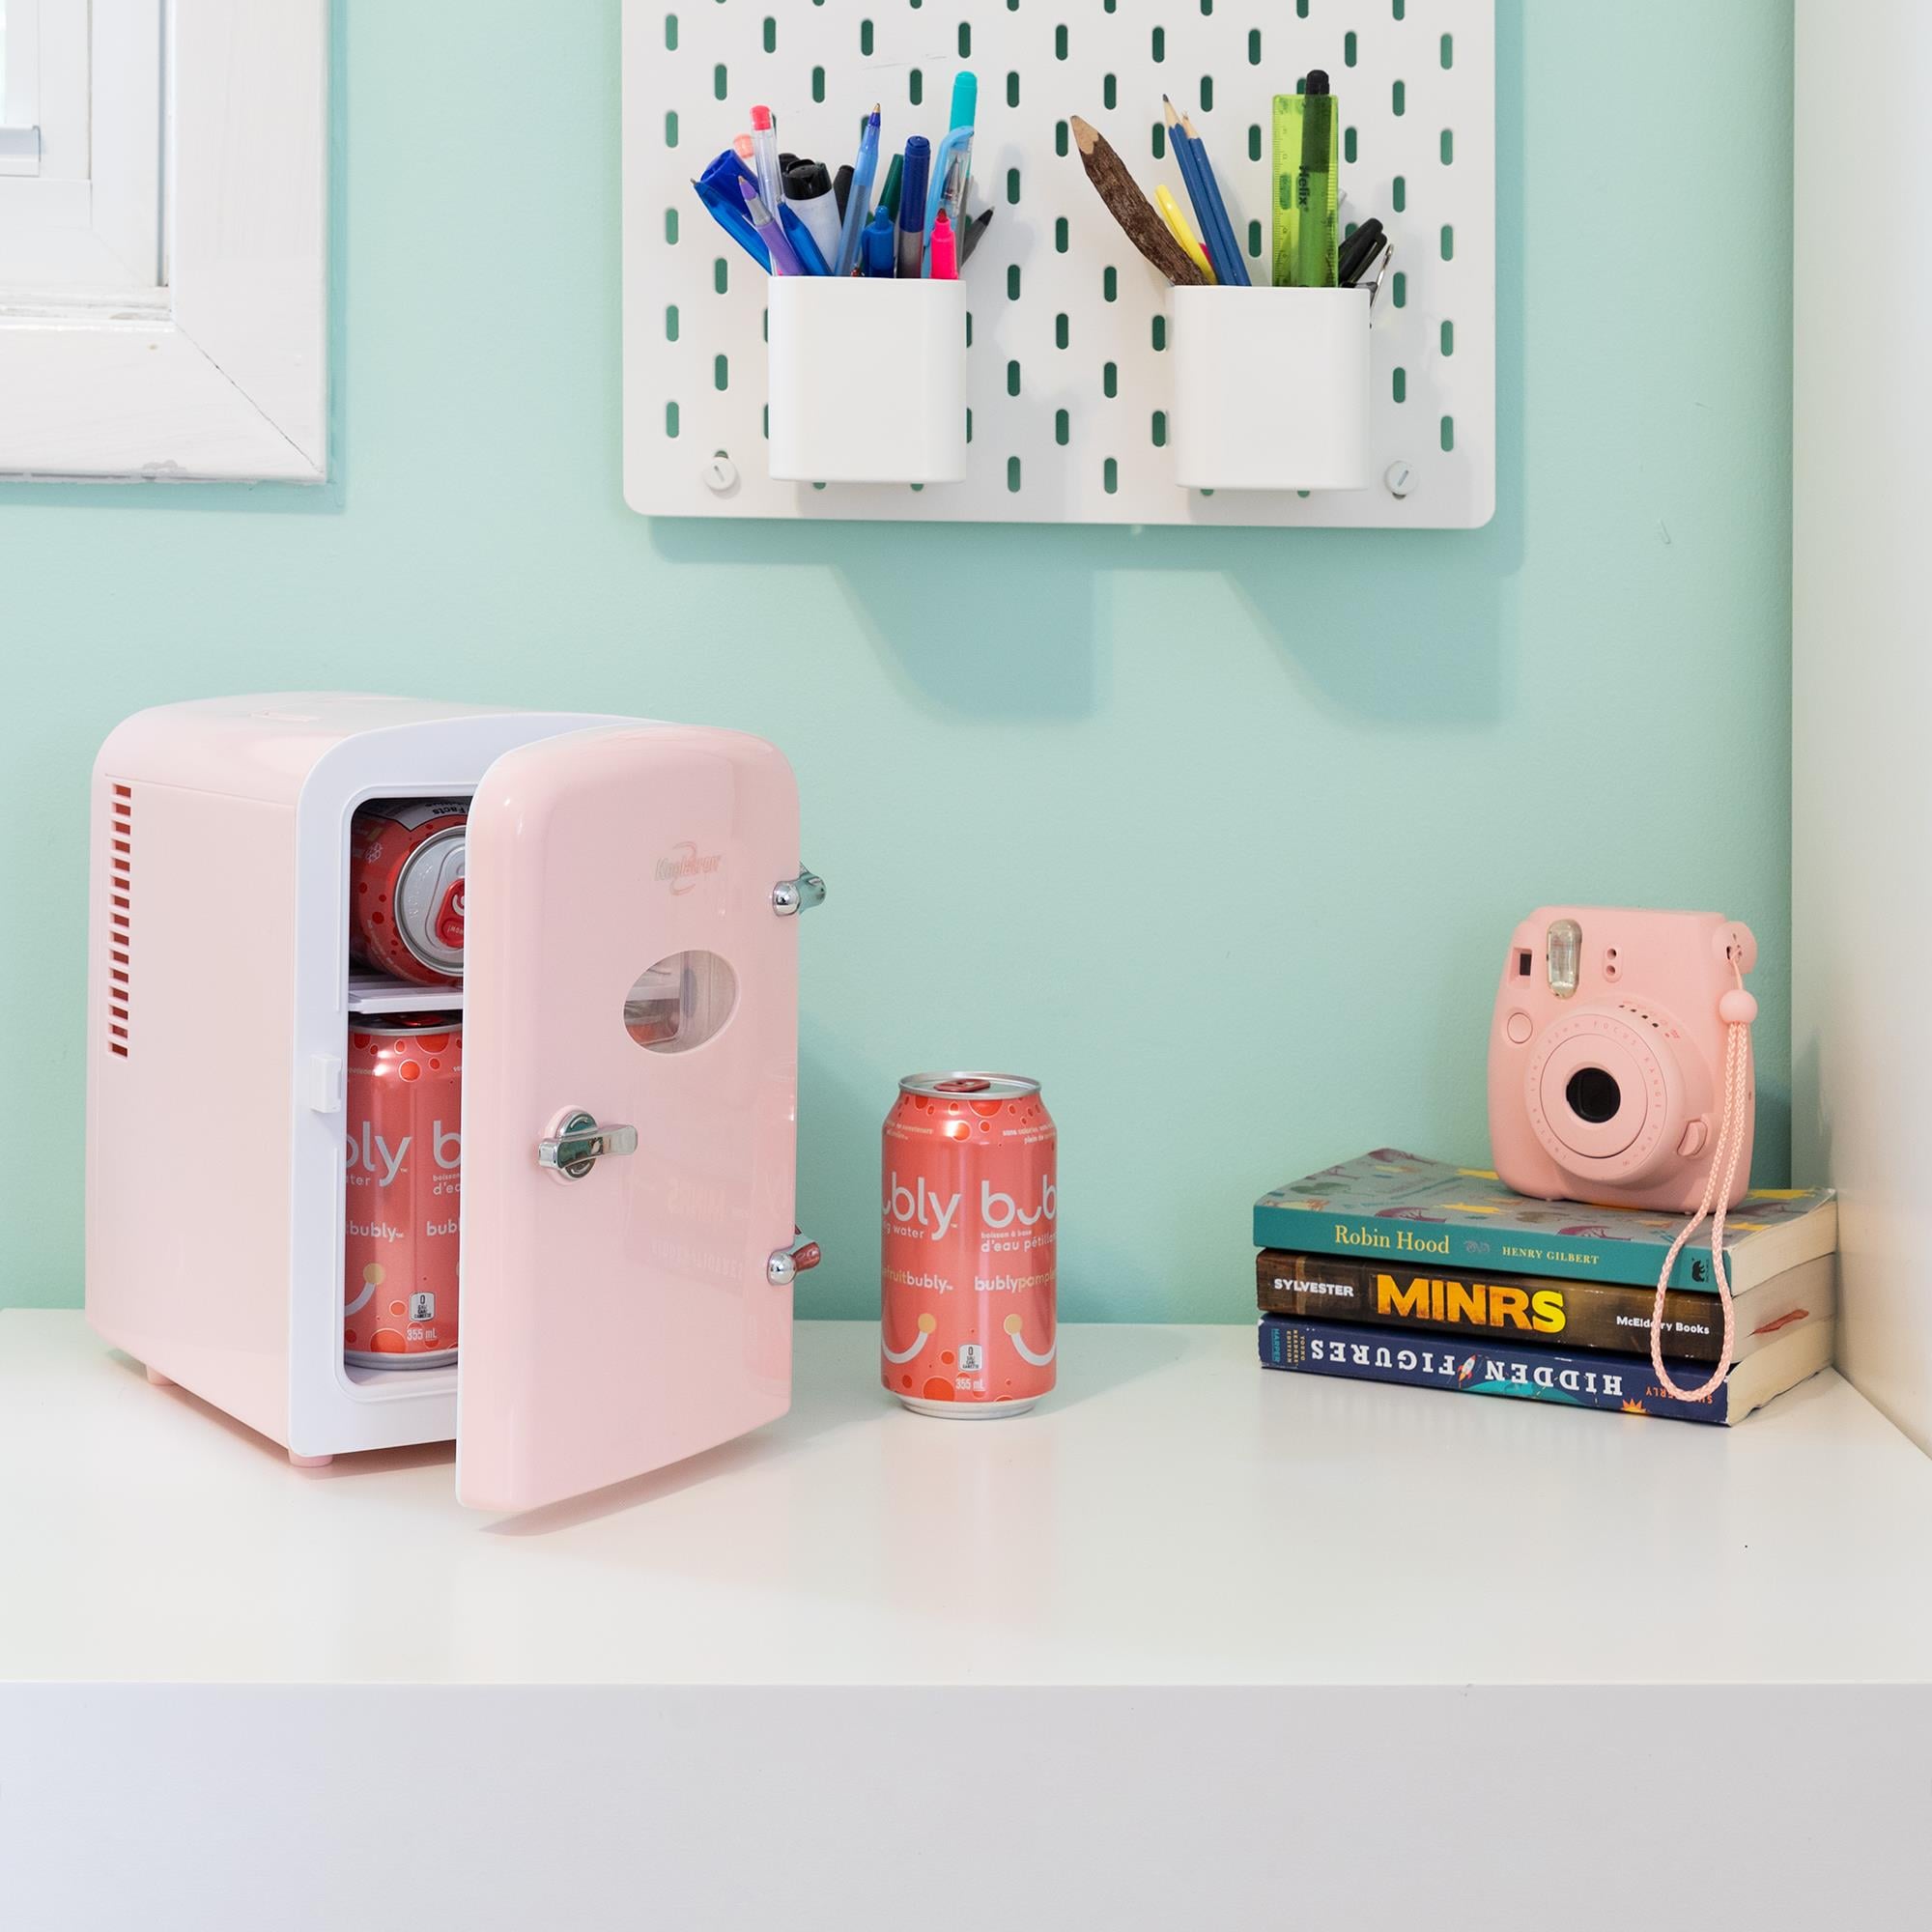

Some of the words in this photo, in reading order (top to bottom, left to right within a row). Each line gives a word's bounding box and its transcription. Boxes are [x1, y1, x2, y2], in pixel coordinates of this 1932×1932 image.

[1298, 165, 1310, 206] Helix
[347, 1176, 371, 1186] ter
[348, 1220, 397, 1242] bubly
[894, 1226, 924, 1238] water
[1335, 1225, 1390, 1248] Robin
[1397, 1231, 1450, 1254] Hood
[981, 1238, 1019, 1253] d'eau
[1502, 1246, 1543, 1259] HENRY
[1547, 1251, 1600, 1264] GILBERT
[1274, 1278, 1354, 1297] SYLVESTER
[419, 1294, 425, 1304] 0
[1377, 1274, 1566, 1334] MINRS
[407, 1328, 423, 1341] 355
[1616, 1316, 1672, 1333] McEldry
[1675, 1322, 1710, 1335] Books
[968, 1346, 974, 1355] 0
[1310, 1340, 1456, 1376] FIGURES
[955, 1378, 971, 1391] 355
[1485, 1359, 1623, 1397] HIDDEN
